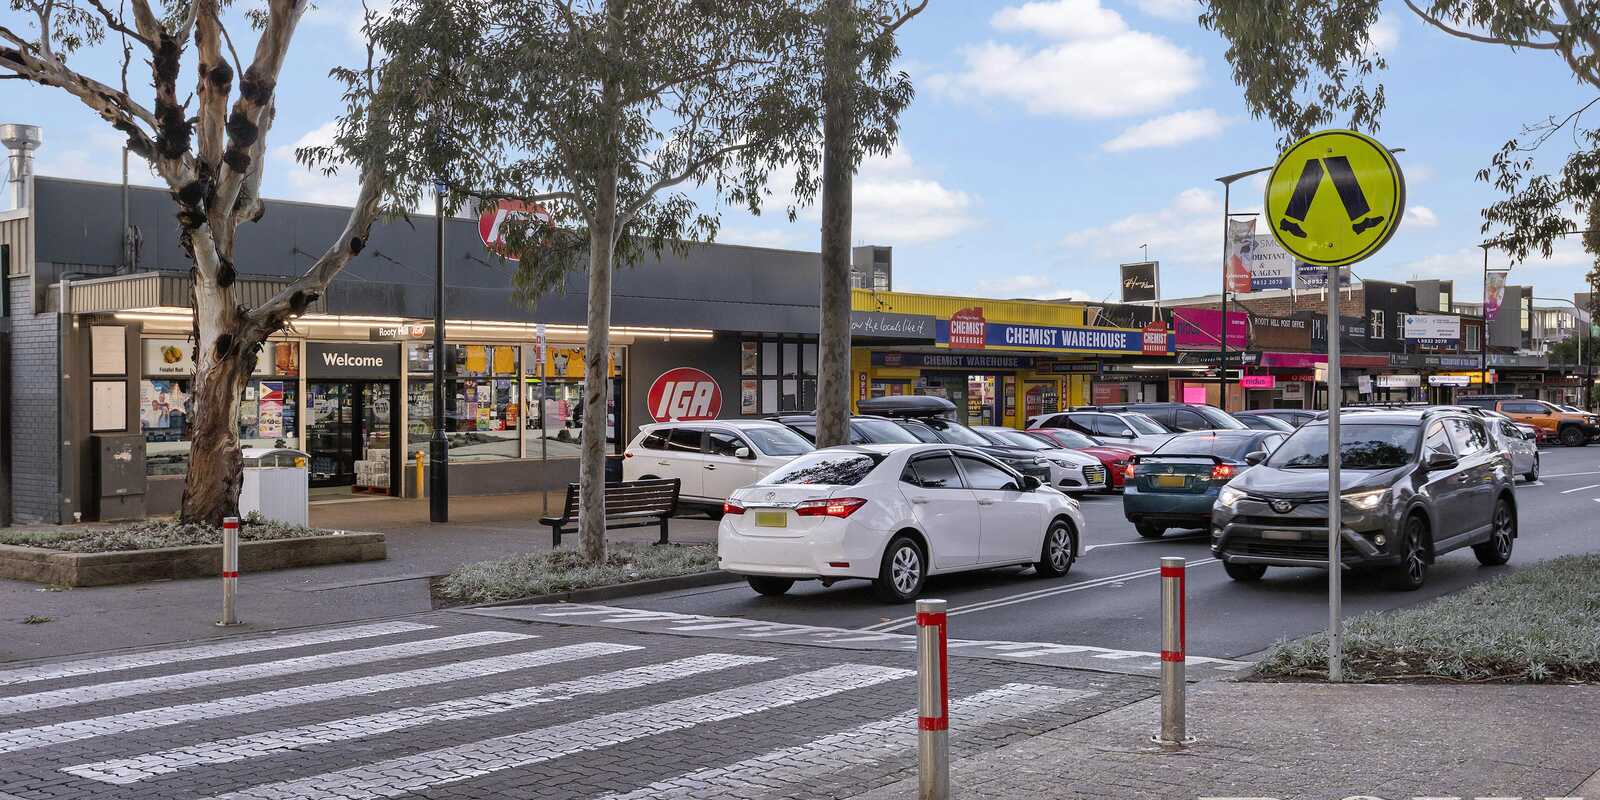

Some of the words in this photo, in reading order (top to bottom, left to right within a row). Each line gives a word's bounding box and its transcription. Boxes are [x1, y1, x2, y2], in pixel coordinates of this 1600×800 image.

[864, 317, 878, 332] the
[880, 318, 901, 331] locals
[901, 318, 916, 332] like
[951, 320, 985, 336] CHEMIST
[1254, 317, 1269, 326] ROOTY
[1270, 318, 1280, 327] HILL
[1280, 319, 1291, 328] POST
[1291, 320, 1305, 329] OFFICE
[379, 326, 397, 337] Rooty
[398, 325, 408, 336] Hill
[1005, 327, 1057, 346] CHEMIST
[1061, 329, 1127, 349] WAREHOUSE
[951, 336, 984, 344] WAREHOUSE
[1143, 332, 1167, 345] CHEMIST
[322, 352, 384, 367] Welcome
[923, 355, 962, 367] CHEMIST
[966, 356, 1018, 367] WAREHOUSE
[655, 381, 715, 420] IGA
